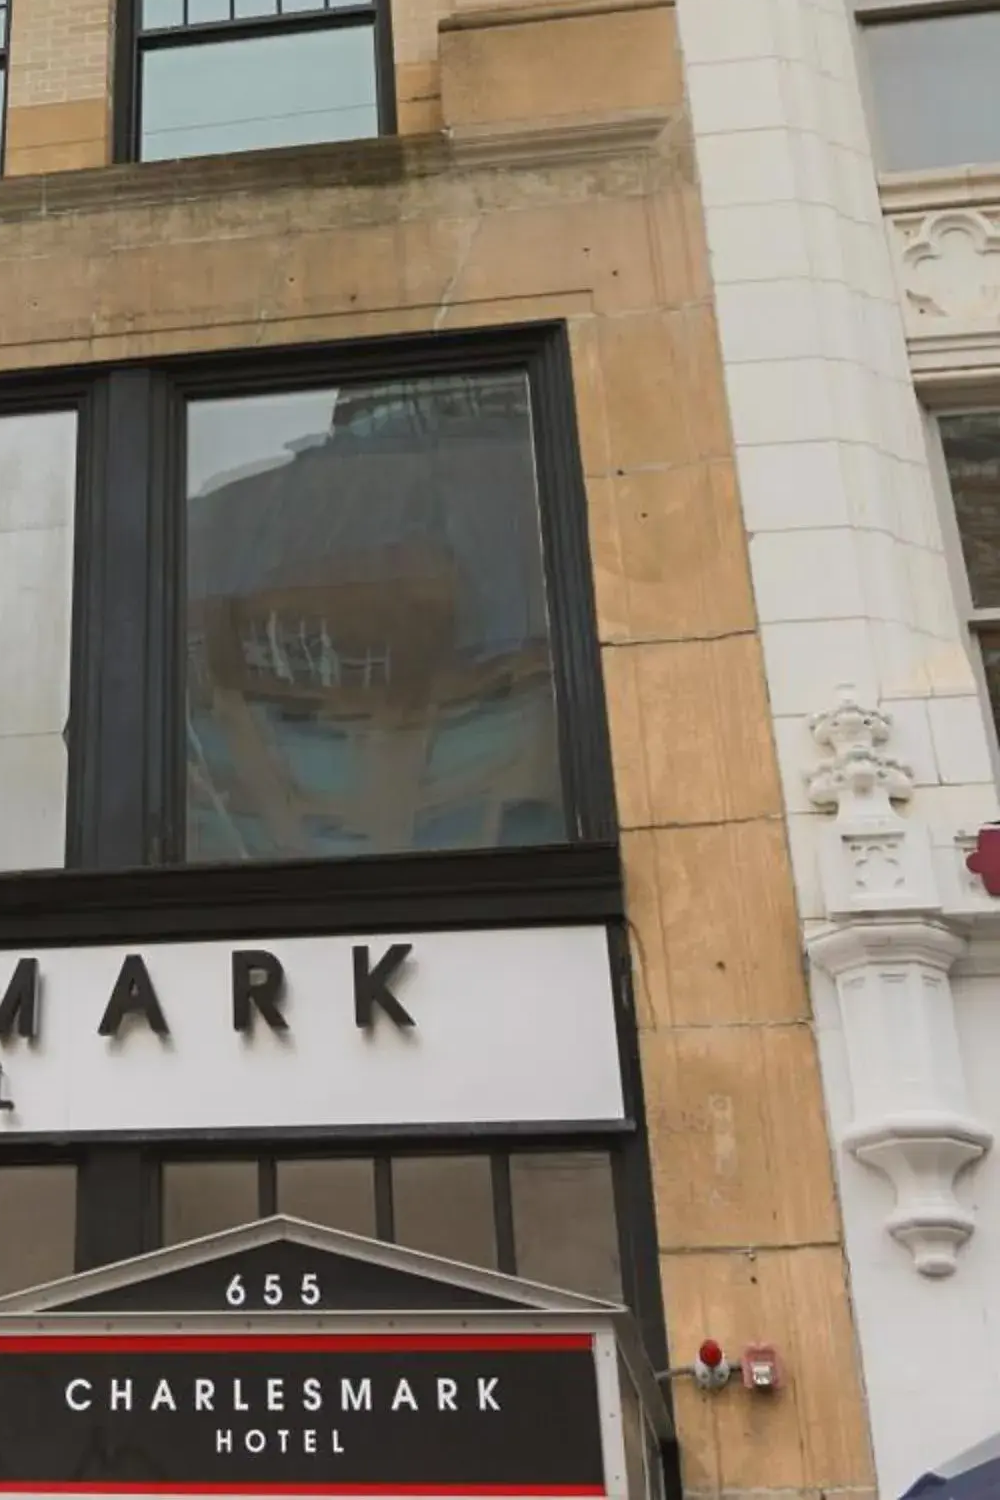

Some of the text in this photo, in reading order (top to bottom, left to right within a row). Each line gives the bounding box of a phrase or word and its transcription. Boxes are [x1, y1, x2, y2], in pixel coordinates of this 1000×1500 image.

[226, 1273, 321, 1305] 655
[65, 1378, 502, 1412] CHARLESMARK
[216, 1429, 344, 1453] HOTEL
